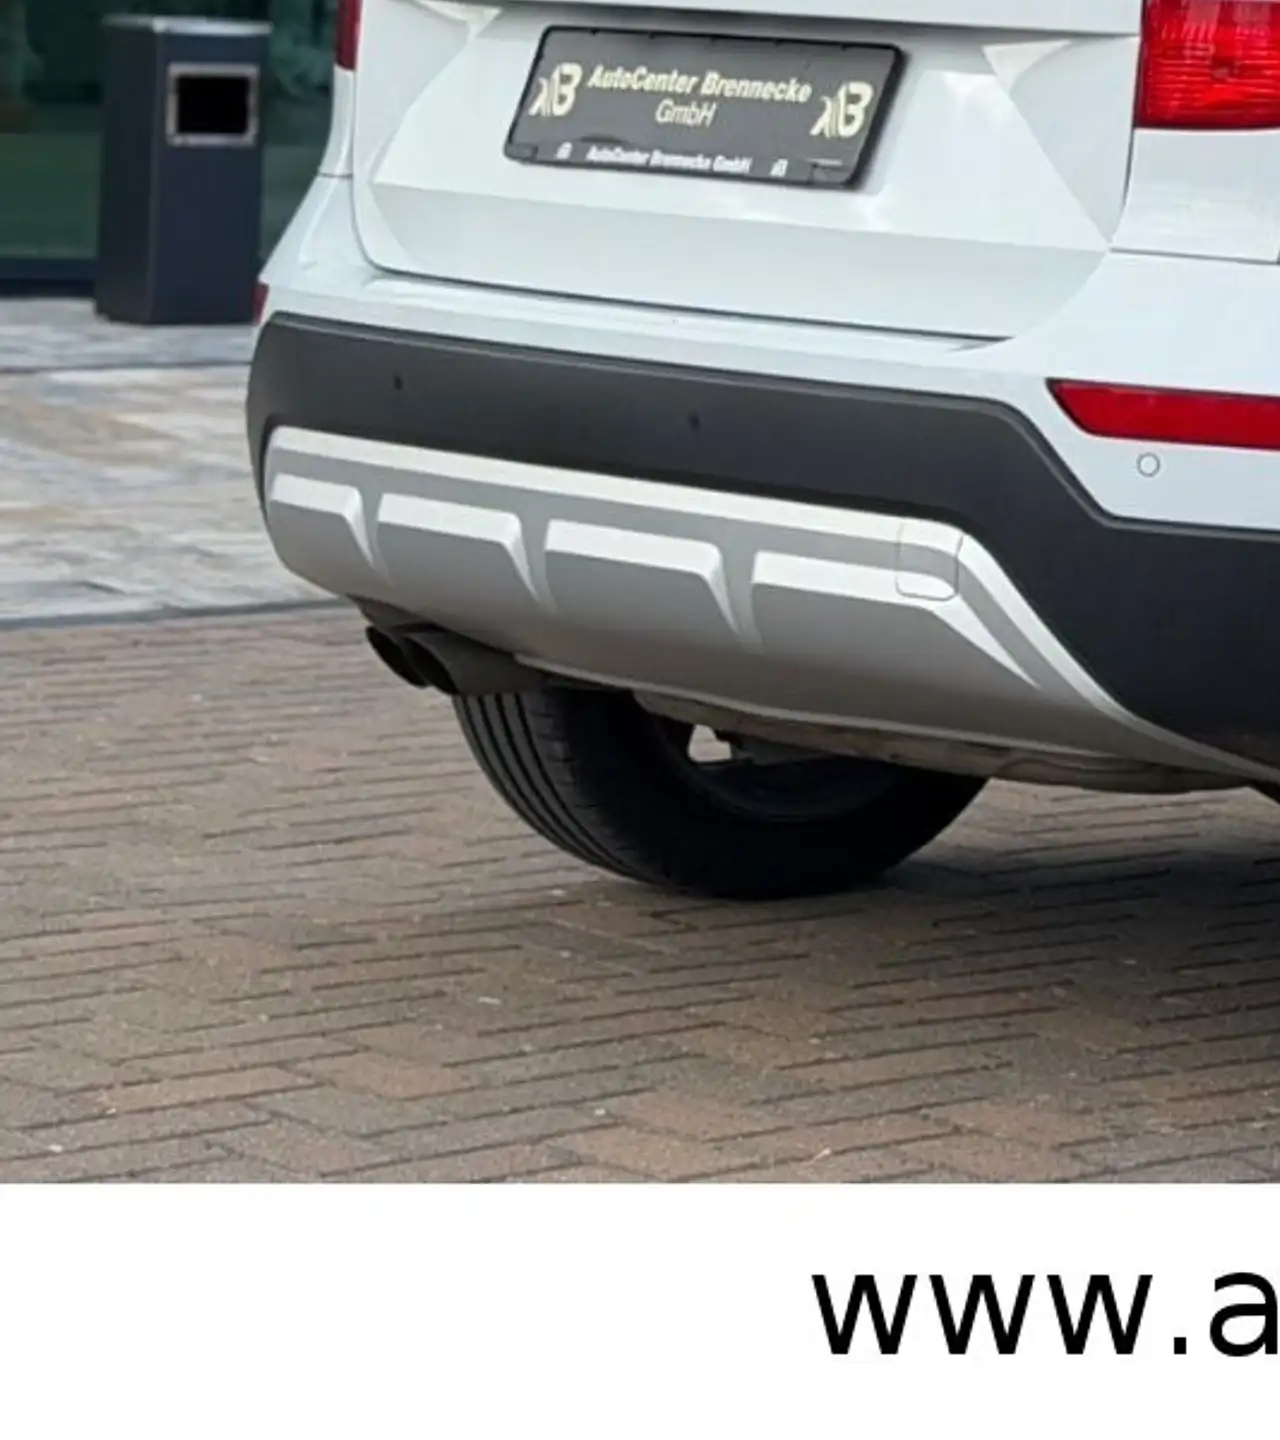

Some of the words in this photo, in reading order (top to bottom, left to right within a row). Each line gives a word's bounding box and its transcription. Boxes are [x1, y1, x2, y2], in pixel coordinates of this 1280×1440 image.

[588, 64, 698, 94] AutoCenter
[700, 70, 812, 103] Brennecke
[654, 98, 718, 128] GmbH
